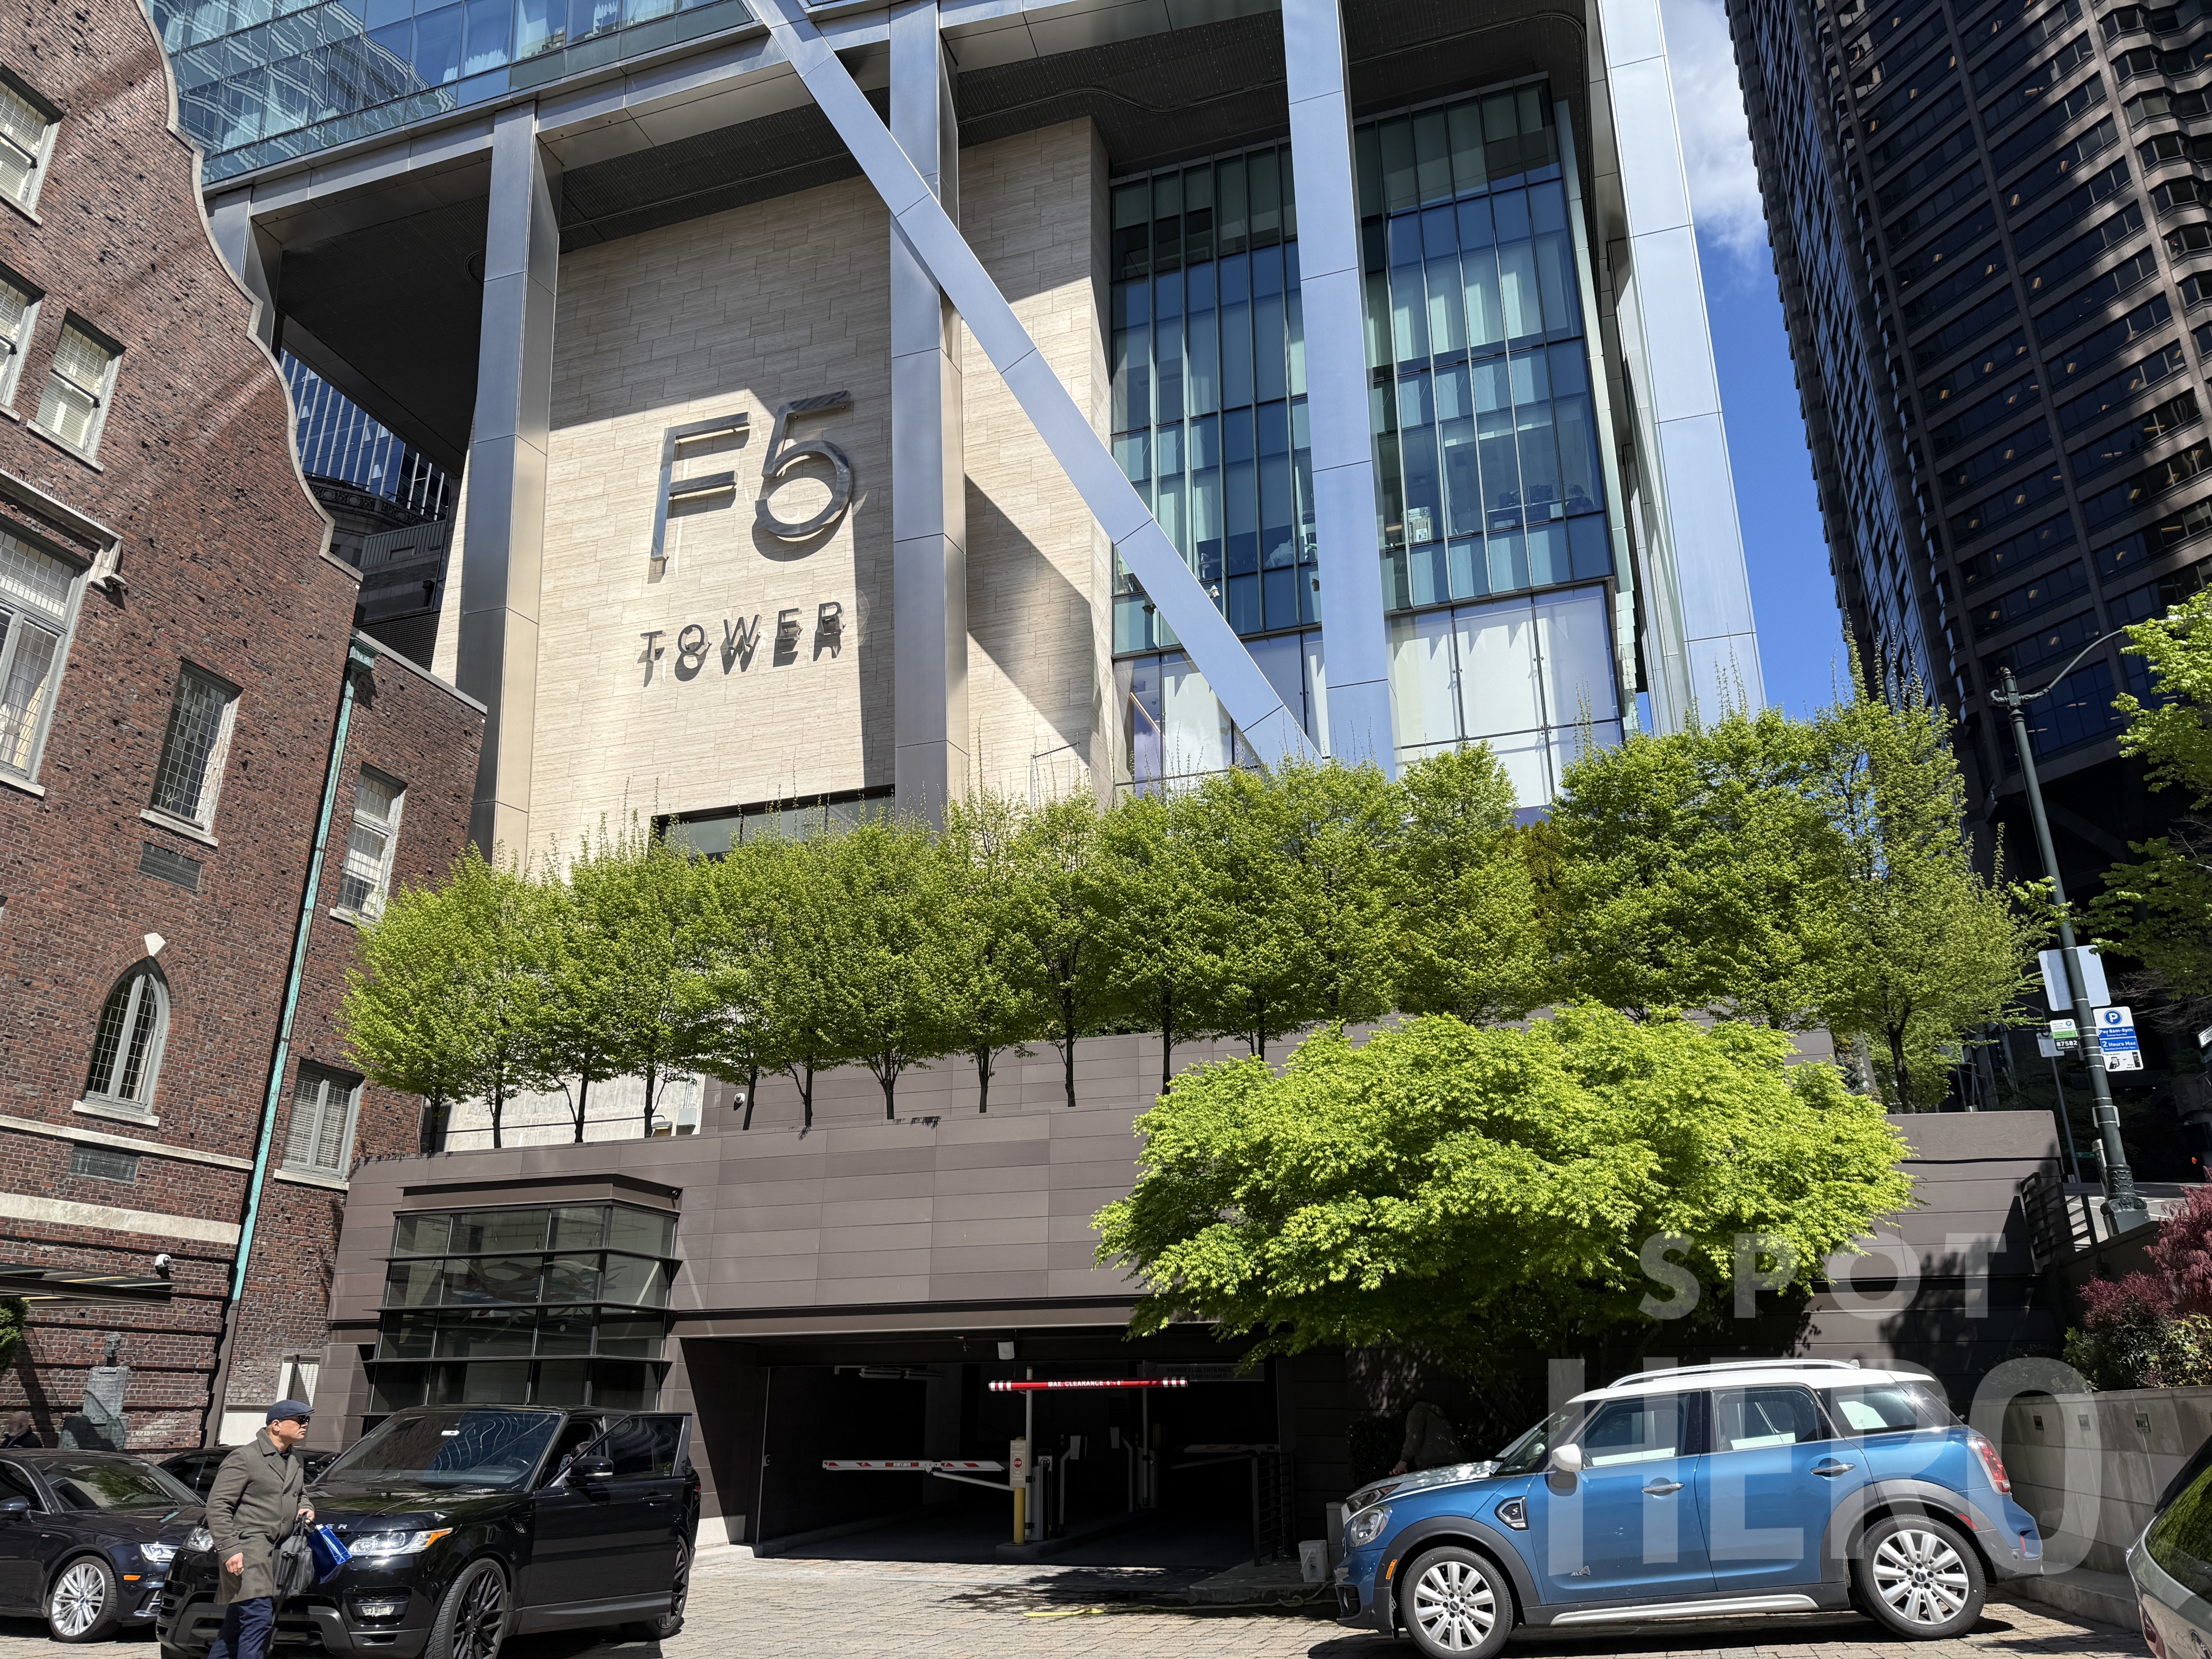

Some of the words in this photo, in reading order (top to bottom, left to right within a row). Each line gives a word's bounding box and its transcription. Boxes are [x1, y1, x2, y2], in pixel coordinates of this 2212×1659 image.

[650, 390, 853, 561] F5
[640, 601, 846, 662] TOWER
[1570, 1566, 1590, 1577] ALL4
